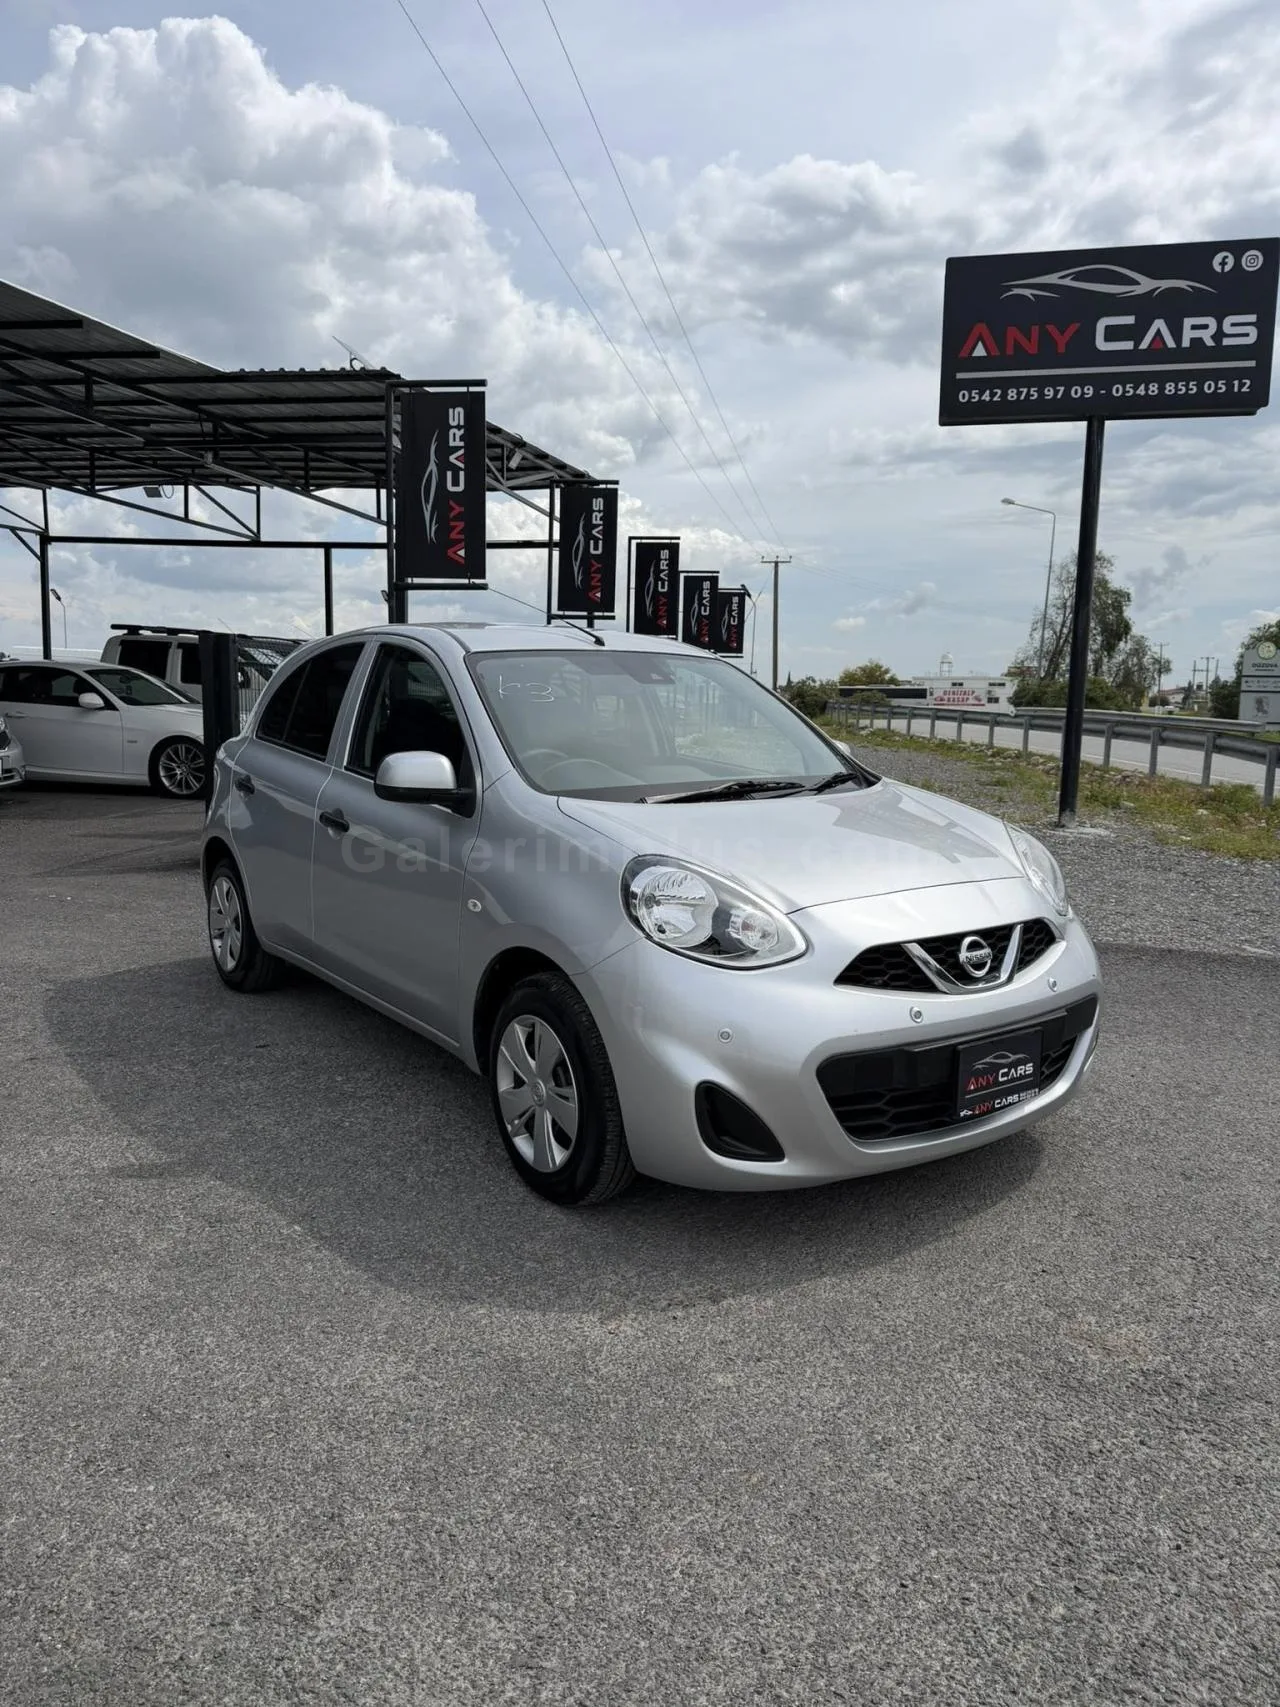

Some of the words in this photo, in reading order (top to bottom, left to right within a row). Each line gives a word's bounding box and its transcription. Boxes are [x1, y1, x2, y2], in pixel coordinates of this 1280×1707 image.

[958, 320, 1080, 358] ANY
[1095, 314, 1258, 351] CARS
[958, 389, 1002, 402] 0542
[1007, 387, 1039, 401] 875
[1044, 386, 1065, 399] 97
[1070, 385, 1094, 398] 09
[1112, 383, 1159, 397] 0548
[1164, 381, 1198, 395] 855
[1203, 380, 1227, 394] 05
[1232, 379, 1251, 392] 12
[446, 406, 466, 493] CARS
[447, 499, 466, 566] ANY
[589, 497, 604, 555] CARS
[588, 559, 603, 602] ANY
[658, 549, 670, 593] CARS
[656, 595, 668, 629] ANY
[701, 580, 711, 616] CARS
[730, 596, 740, 626] CARS
[964, 950, 991, 963] NISSAN
[966, 1072, 996, 1091] ANY
[998, 1062, 1034, 1082] CARS
[994, 1094, 1019, 1108] CARS
